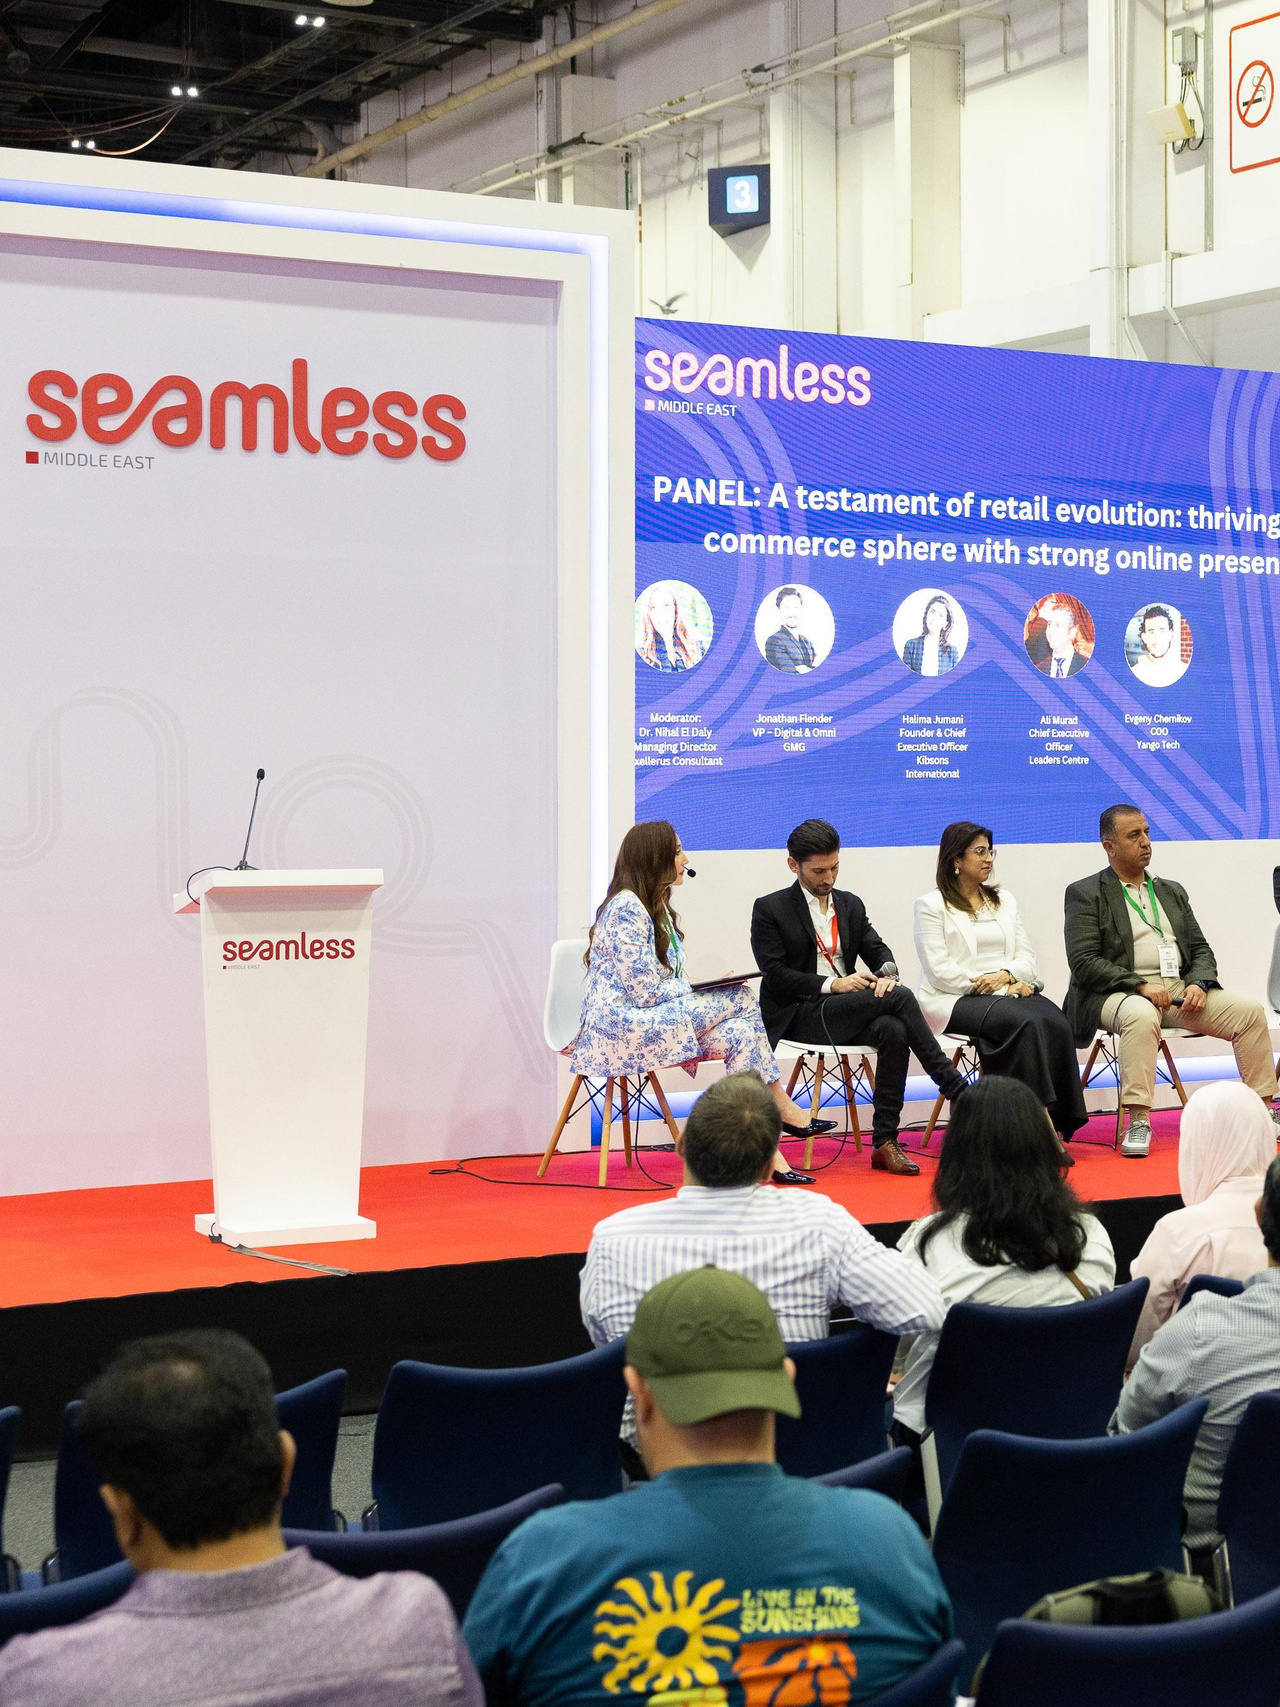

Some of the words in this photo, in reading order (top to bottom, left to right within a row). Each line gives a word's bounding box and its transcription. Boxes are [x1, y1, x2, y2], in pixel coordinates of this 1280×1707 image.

[735, 180, 750, 208] 3
[644, 344, 872, 406] seamless
[26, 357, 467, 461] seamless
[657, 399, 703, 414] MIDDLE
[707, 403, 738, 417] EAST
[44, 451, 108, 468] MIDDLE
[113, 454, 155, 471] EAST
[653, 475, 761, 507] PANEL:
[767, 483, 789, 509] A
[796, 487, 940, 515] testament
[945, 492, 975, 518] of
[980, 495, 1049, 521] retail
[1055, 499, 1182, 528] evolution:
[1188, 505, 1280, 540] thriving
[703, 531, 857, 558] commerce
[863, 533, 957, 566] sphere
[963, 537, 1020, 565] with
[1026, 542, 1110, 575] strong
[1115, 545, 1192, 572] online
[650, 712, 702, 724] Moderator:
[755, 714, 798, 724] Jonathan
[799, 714, 834, 724] Flender
[902, 714, 931, 725] Halima
[932, 714, 964, 725] Jumani
[1040, 716, 1051, 726] Ali
[1052, 716, 1078, 726] Murad
[1124, 714, 1152, 726] Evgeny
[1153, 714, 1193, 724] Chernikov
[639, 727, 653, 738] Dr.
[655, 727, 680, 738] Nihal
[680, 727, 691, 738] El
[692, 728, 713, 740] Daly
[752, 728, 766, 738] VP
[774, 728, 802, 740] Digital
[804, 728, 812, 738] &
[812, 728, 837, 738] Omni
[899, 728, 934, 738] Founder
[935, 728, 942, 738] &
[944, 728, 966, 738] Chief
[1028, 728, 1050, 739] Chief
[1051, 728, 1090, 739] Executive
[1150, 727, 1169, 736] COO
[634, 742, 678, 754] Managing
[680, 742, 718, 752] Director
[783, 742, 806, 752] GMG
[897, 742, 938, 752] Executive
[939, 742, 969, 752] Officer
[1045, 742, 1074, 752] Officer
[1136, 740, 1160, 751] Yango
[1161, 740, 1181, 750] Tech
[634, 756, 671, 766] xellerus
[672, 756, 723, 766] Consultant
[916, 755, 950, 766] Kibsons
[1029, 755, 1061, 765] Leaders
[1062, 755, 1090, 765] Centre
[905, 768, 960, 779] International
[222, 931, 356, 961] seamless
